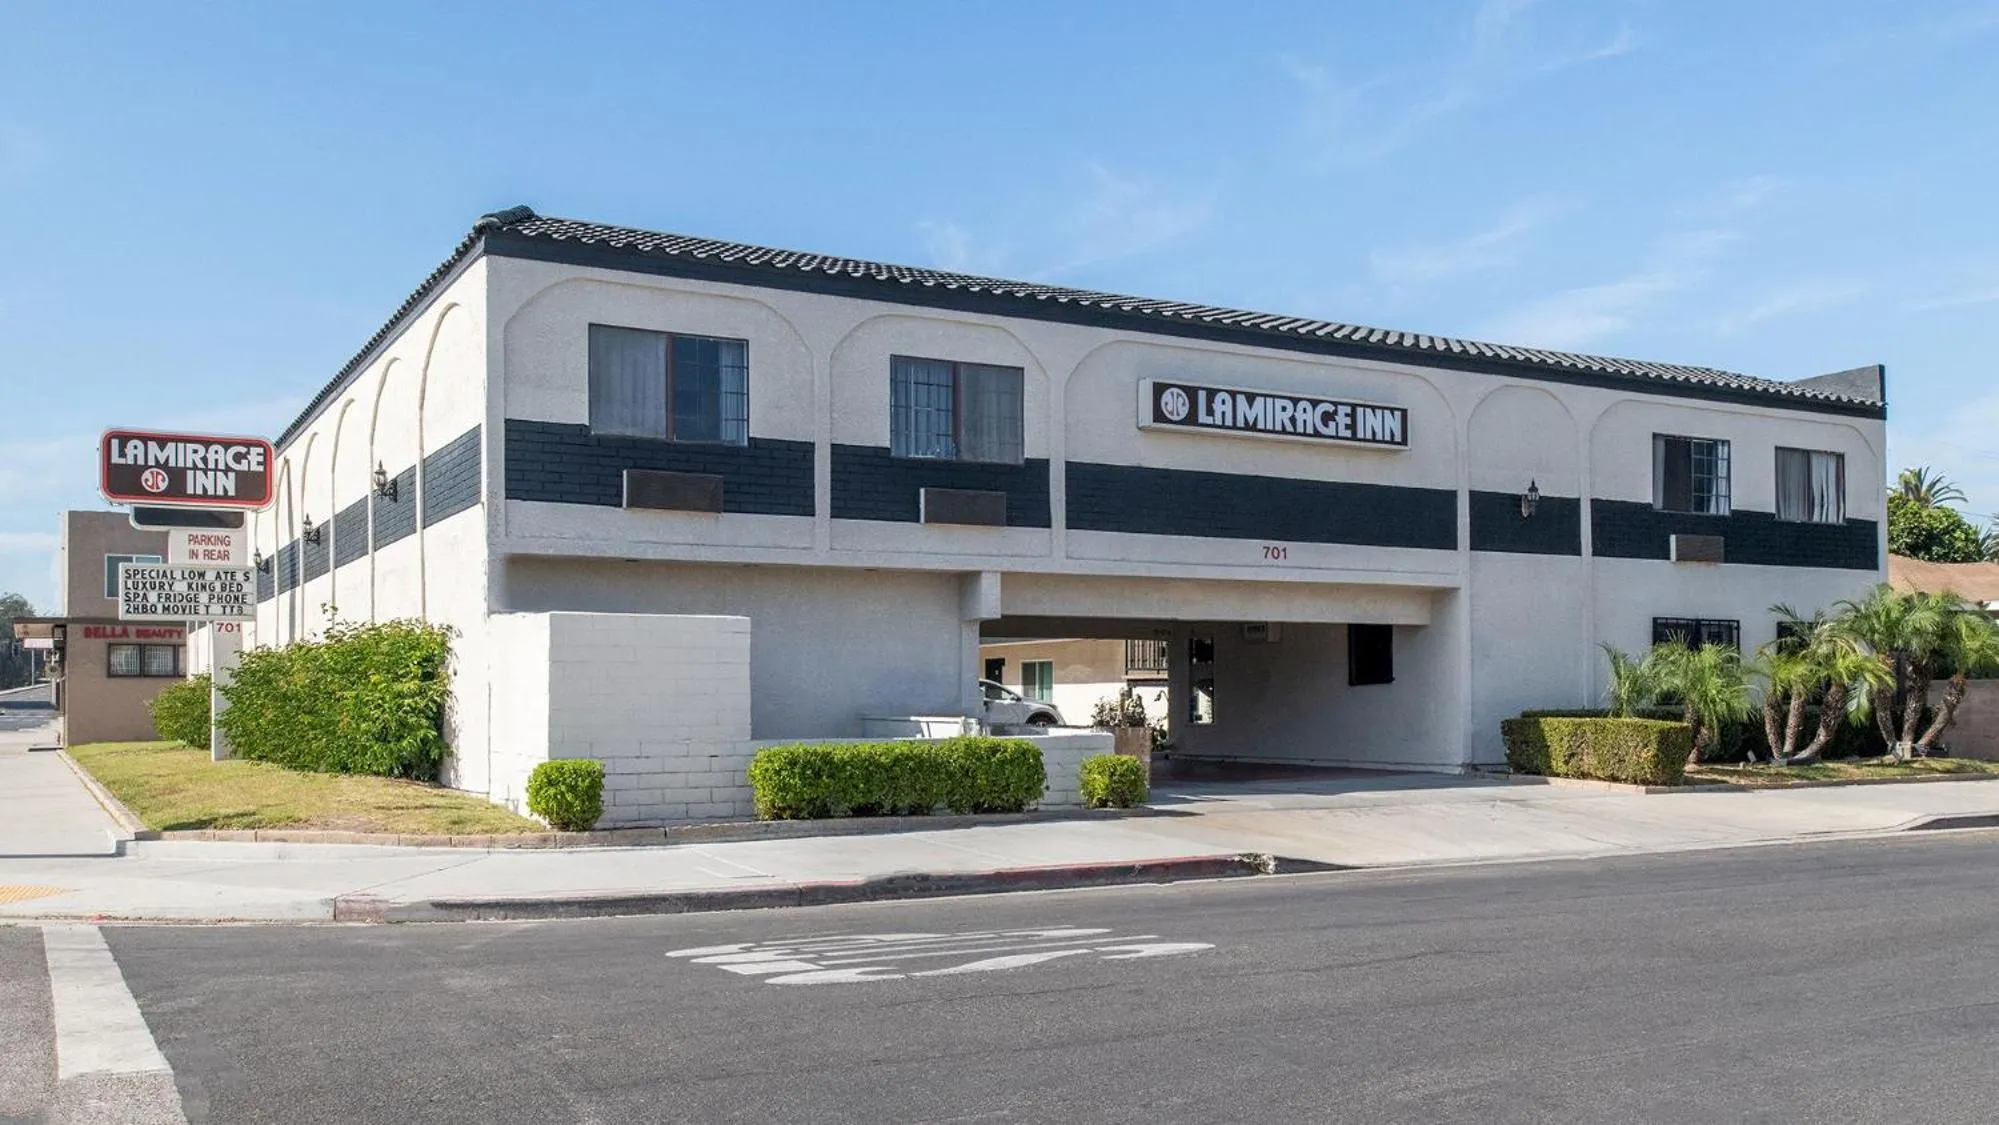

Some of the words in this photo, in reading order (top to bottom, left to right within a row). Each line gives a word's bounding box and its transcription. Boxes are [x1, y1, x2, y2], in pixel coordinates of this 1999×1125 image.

[1356, 407, 1401, 442] INN
[186, 470, 236, 497] INN
[188, 533, 231, 548] PARKING
[189, 549, 199, 560] IN
[203, 549, 230, 562] REAR
[1263, 546, 1287, 560] 701
[124, 568, 177, 580] SPECIAL
[181, 570, 206, 581] LOW
[124, 580, 175, 591] LUXURY
[187, 582, 216, 592] KING
[220, 583, 244, 593] BED
[124, 591, 149, 602] SPA
[157, 592, 200, 604] FRIDGE
[208, 593, 248, 605] PHONE
[125, 603, 158, 614] 2HBO
[83, 624, 129, 639] BELLA
[135, 627, 184, 639] BEAUTY
[216, 622, 241, 633] 701
